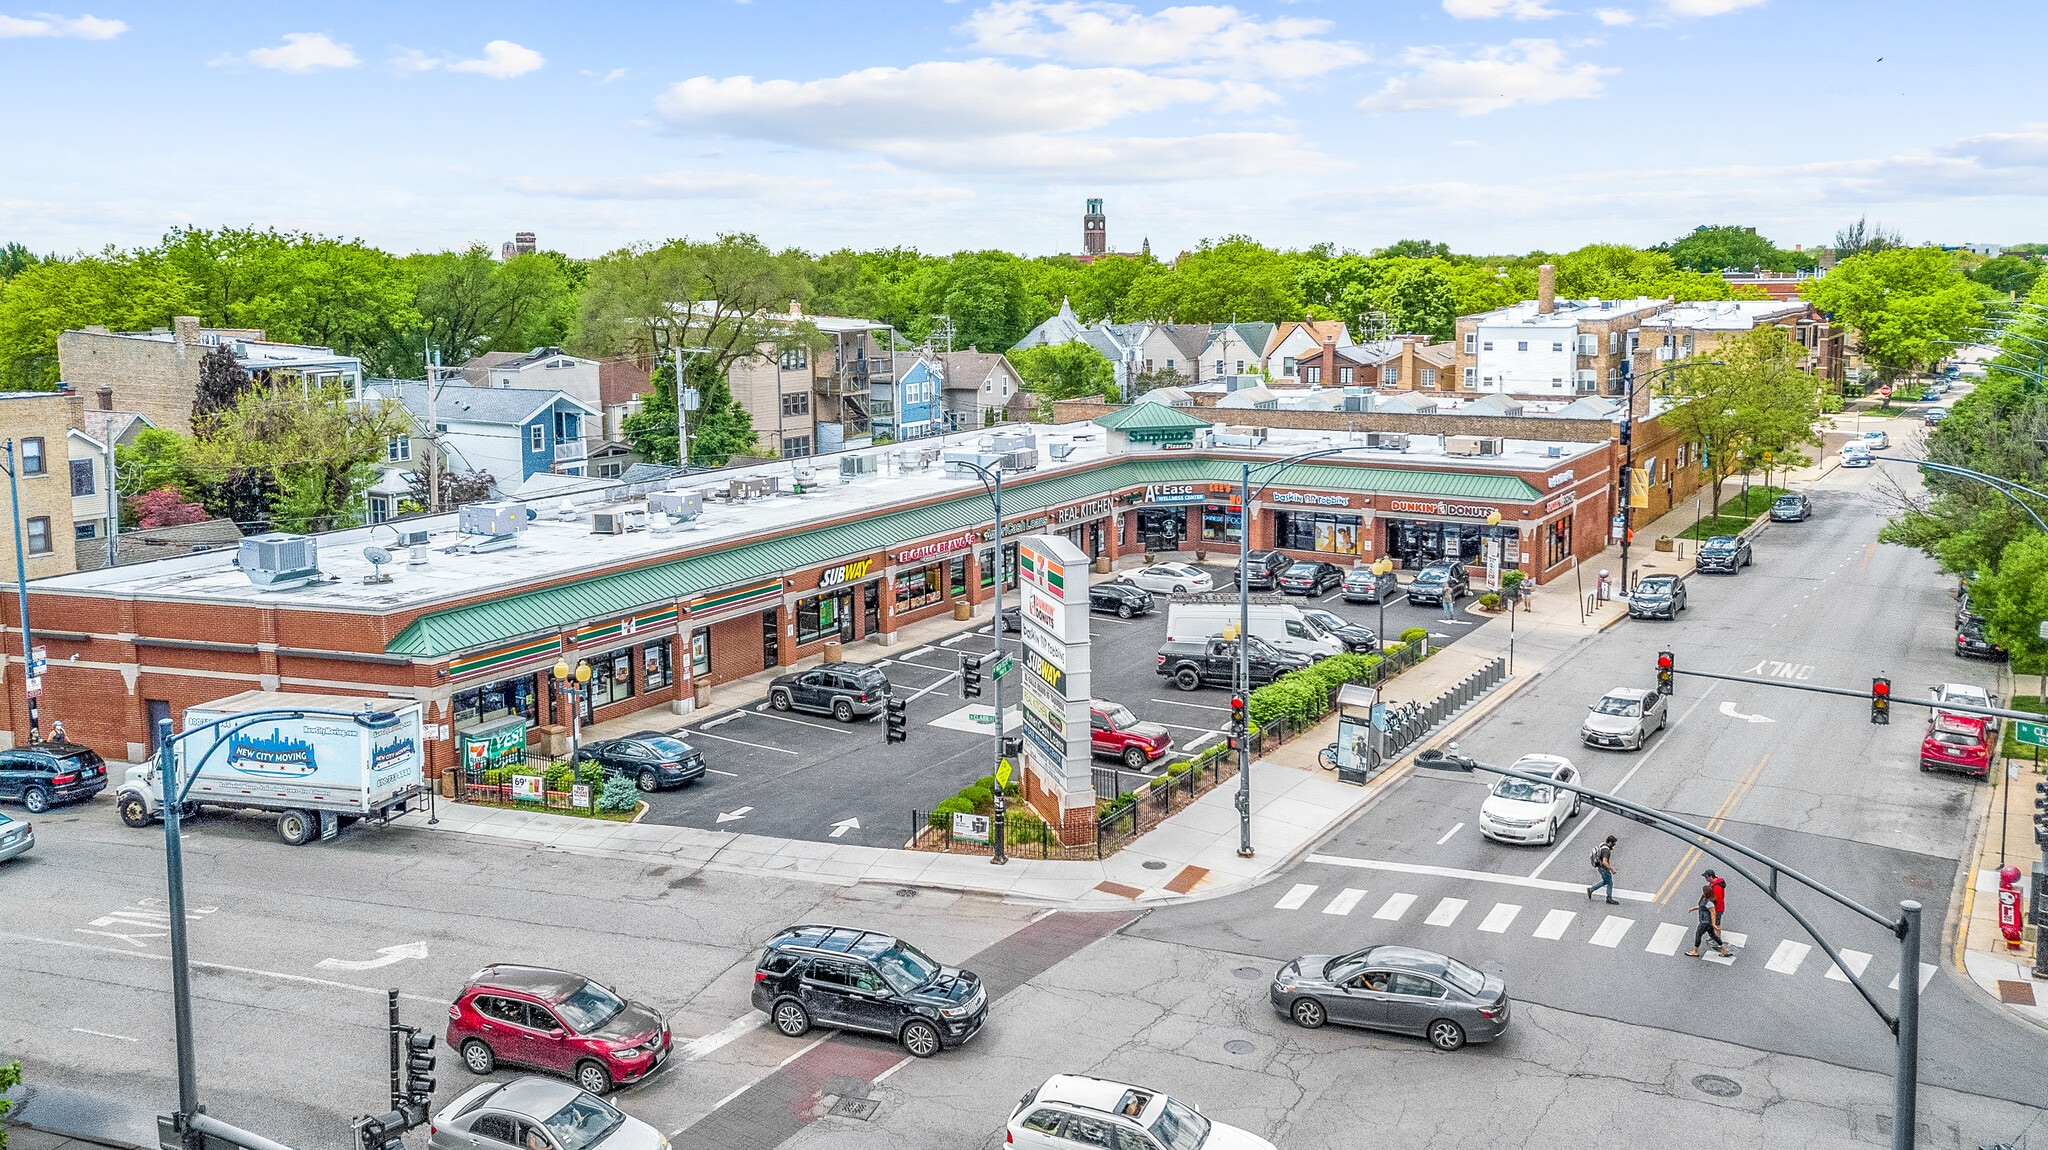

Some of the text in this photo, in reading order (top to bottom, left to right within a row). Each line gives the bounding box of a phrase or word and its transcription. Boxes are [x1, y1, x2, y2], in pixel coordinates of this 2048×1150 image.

[1129, 430, 1193, 445] Sarpino's
[1145, 485, 1160, 502] At
[1163, 484, 1193, 494] Ease
[1230, 494, 1242, 504] WO
[1273, 492, 1303, 503] baskin
[1317, 496, 1349, 506] robbins
[1058, 506, 1079, 523] REAL
[1080, 497, 1113, 518] KITCHEN
[1391, 501, 1437, 514] DUNKIN'
[984, 516, 1048, 541] AmriCash Loans
[1226, 516, 1242, 524] FOO
[900, 550, 911, 562] EL
[911, 544, 938, 560] GALLO
[938, 533, 976, 553] BRAVO'S
[820, 558, 873, 588] SUBWAY
[1027, 650, 1061, 687] SUBWAY
[1742, 660, 1815, 680] ONLY
[496, 726, 523, 749] YES!
[236, 746, 307, 761] NEW CITY MOVING
